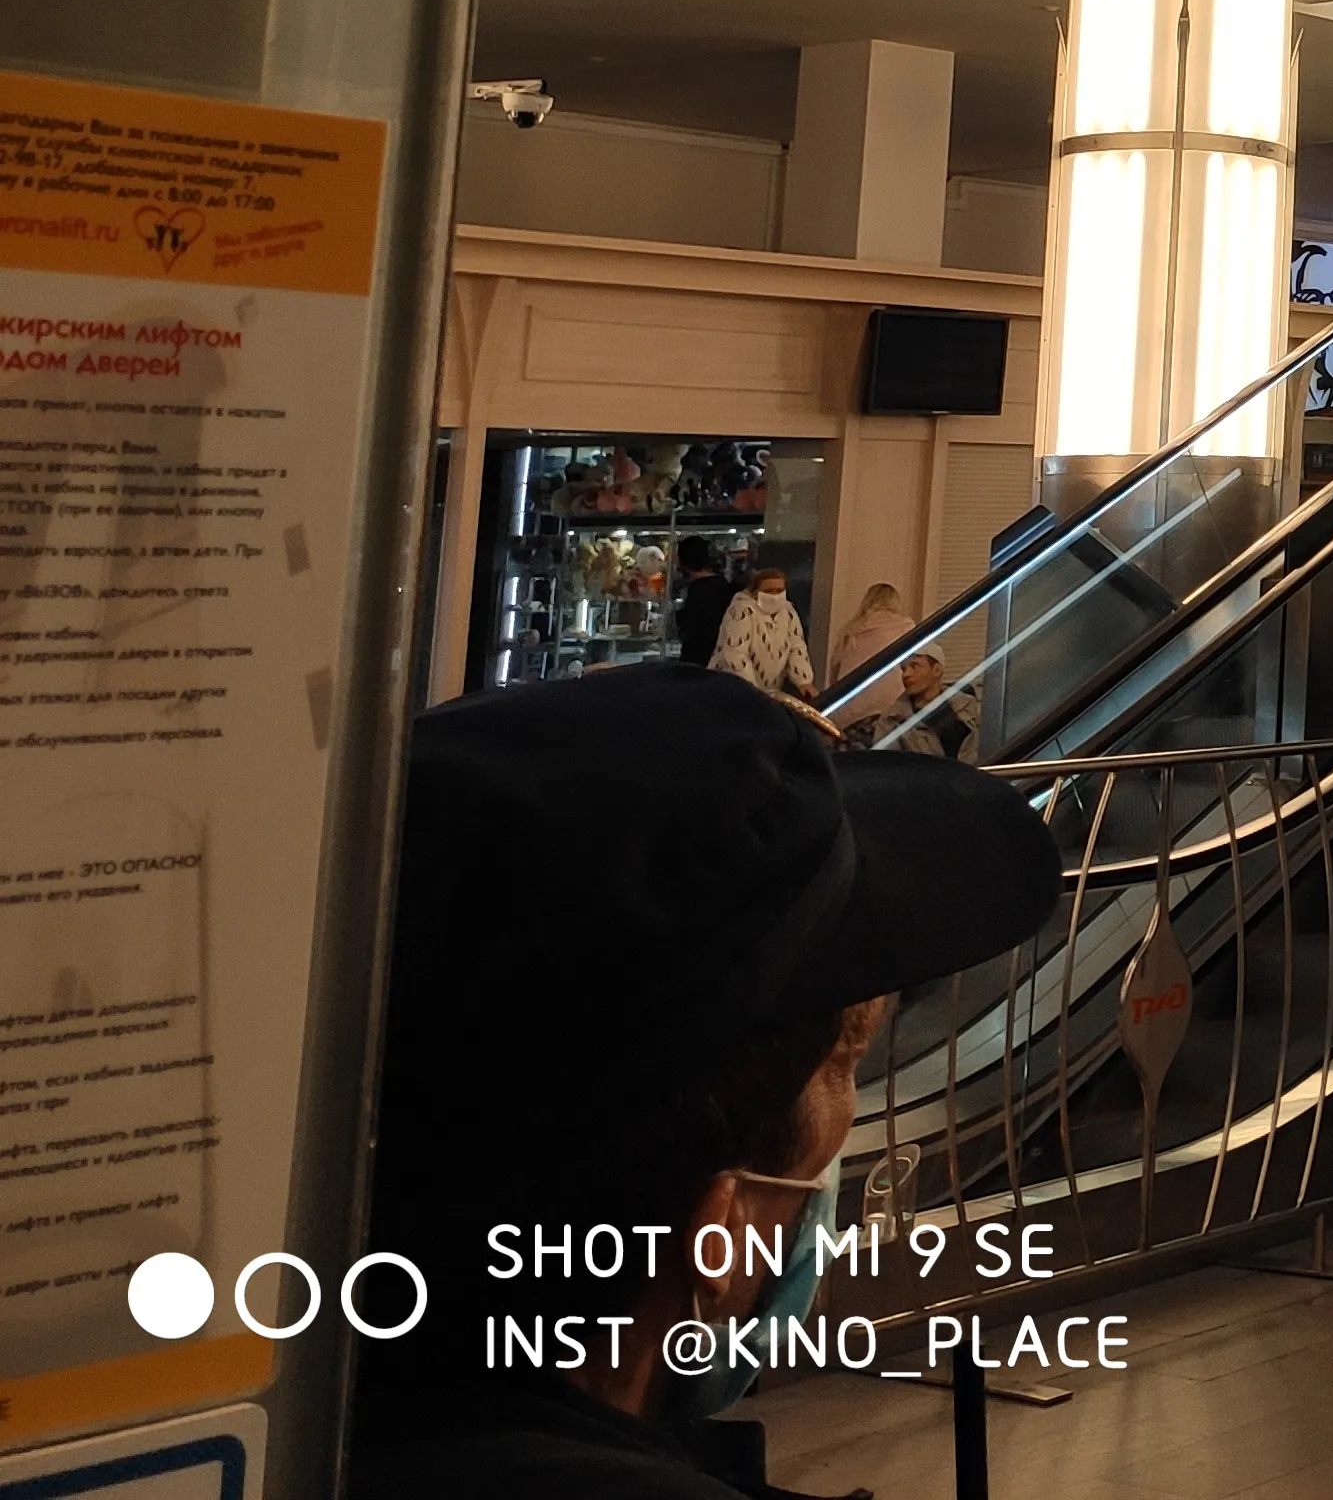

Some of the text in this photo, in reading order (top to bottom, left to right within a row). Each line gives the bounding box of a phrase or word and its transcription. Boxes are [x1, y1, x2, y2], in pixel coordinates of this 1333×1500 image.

[134, 319, 242, 352] лифтом
[75, 348, 181, 381] дверей
[79, 859, 118, 878] ЭТО
[121, 853, 202, 874] ОПАСНО!
